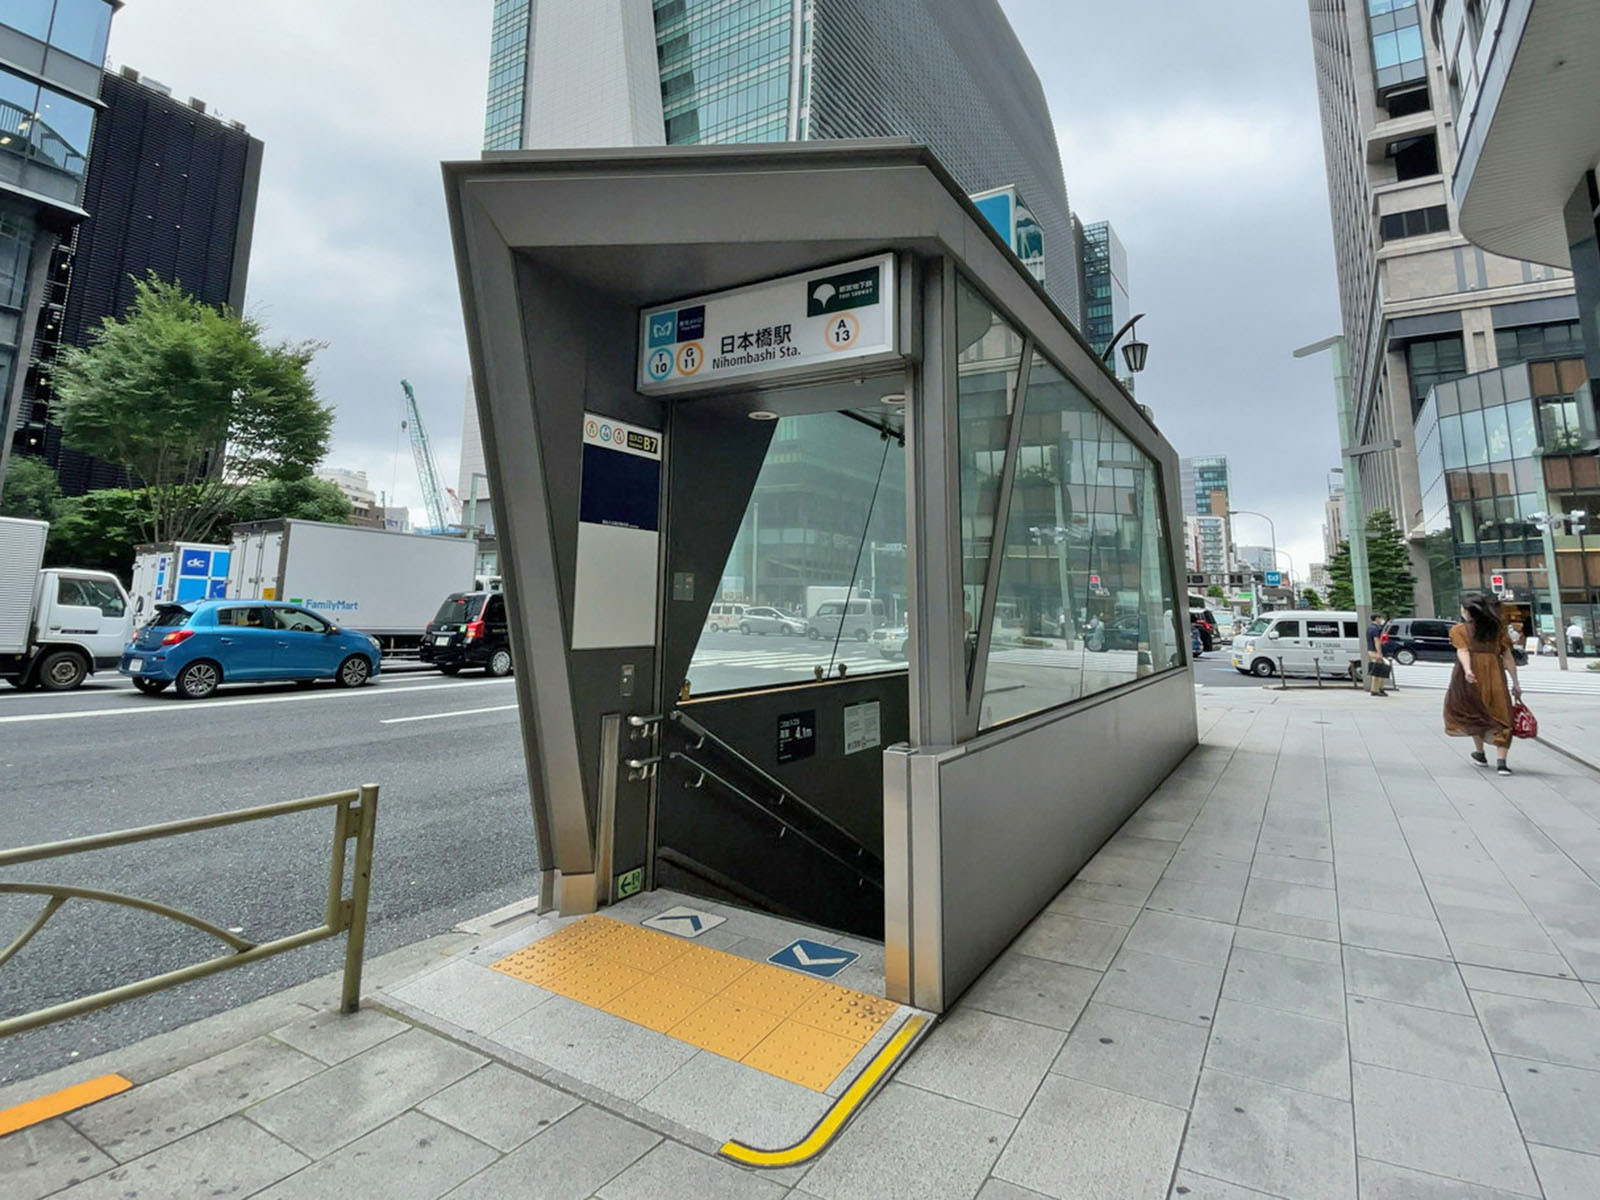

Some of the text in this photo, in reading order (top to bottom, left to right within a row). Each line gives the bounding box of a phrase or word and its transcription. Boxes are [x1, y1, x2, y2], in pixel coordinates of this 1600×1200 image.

[837, 319, 846, 329] A
[720, 323, 792, 356] 日本橋駅
[835, 330, 850, 342] 13
[658, 353, 664, 363] T
[686, 347, 694, 357] G
[712, 345, 801, 369] Nihombashi Sta.
[655, 362, 668, 374] 10
[684, 358, 695, 369] 11
[643, 437, 657, 452] B7
[186, 558, 205, 568] dc
[306, 598, 359, 611] FamilyMart
